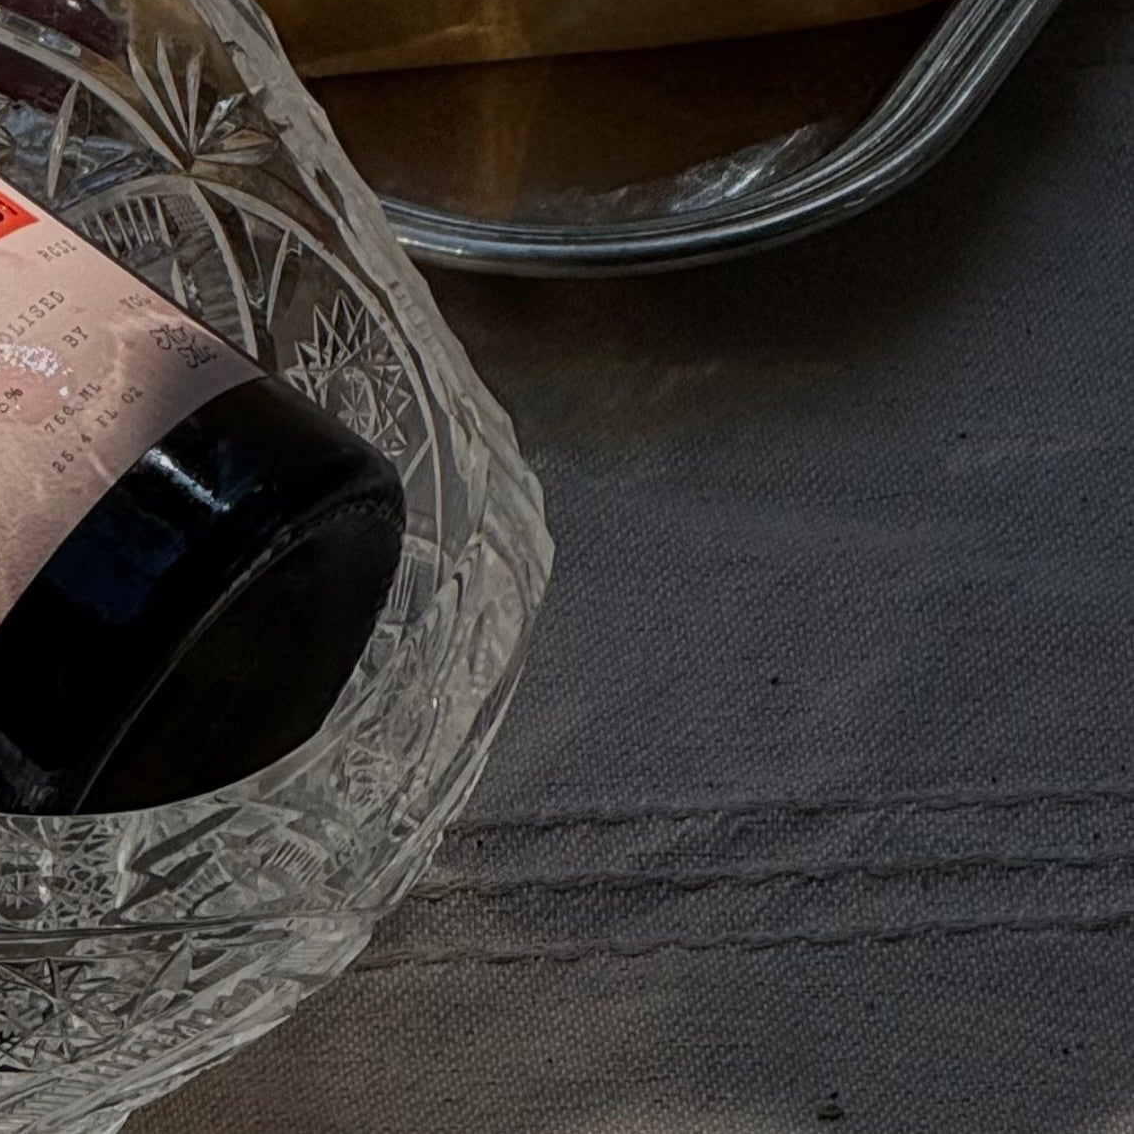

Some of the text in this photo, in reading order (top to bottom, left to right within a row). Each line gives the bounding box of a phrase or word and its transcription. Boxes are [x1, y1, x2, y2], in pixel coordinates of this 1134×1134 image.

[61, 326, 88, 348] BY
[77, 382, 102, 402] ML
[95, 409, 118, 428] FL
